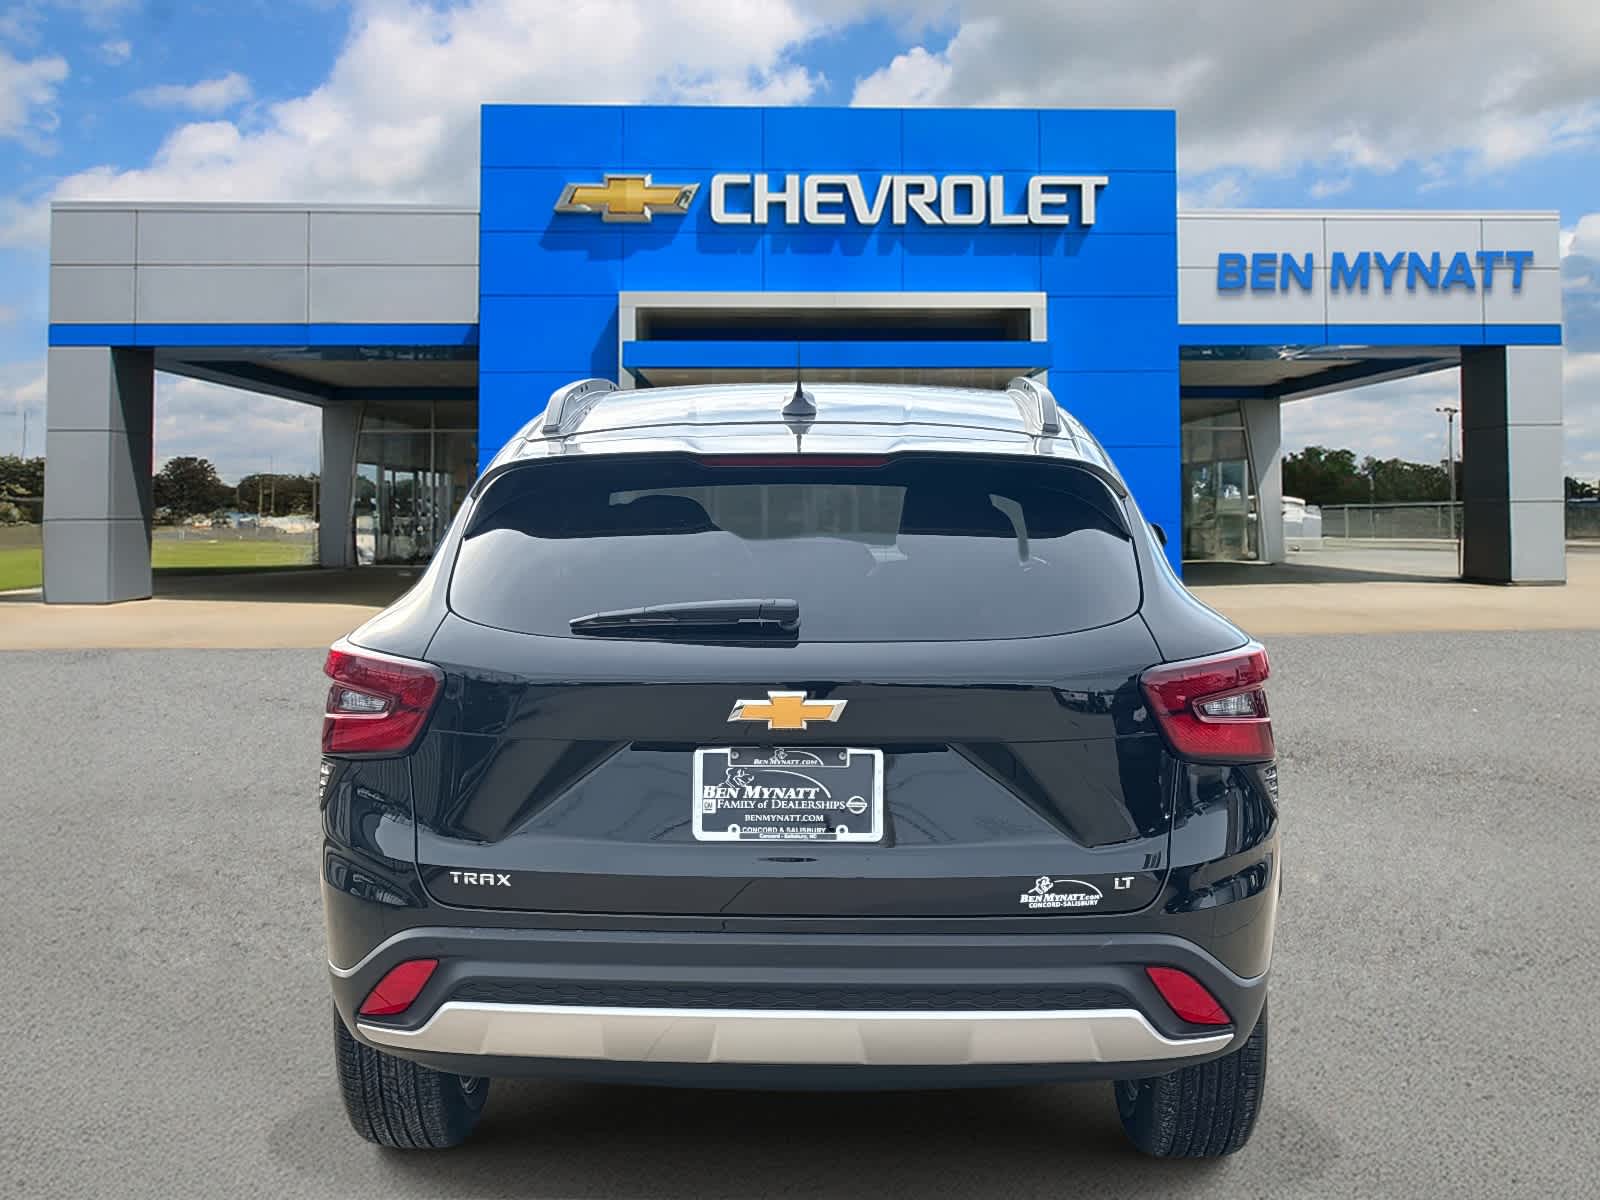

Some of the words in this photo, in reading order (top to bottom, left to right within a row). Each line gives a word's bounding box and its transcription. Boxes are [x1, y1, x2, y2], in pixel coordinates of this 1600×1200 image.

[710, 173, 1109, 226] CHEVROLET
[1217, 252, 1313, 291] BEN
[1330, 251, 1534, 291] MYNATT
[703, 785, 740, 799] BEN
[743, 785, 820, 799] MYNATT
[717, 800, 756, 809] FAMILY
[757, 800, 769, 809] of
[771, 800, 846, 810] DEALERSHIPS
[744, 814, 824, 822] BENMYNATT.COM
[449, 872, 512, 887] TRAX
[1114, 877, 1135, 889] LT
[1020, 893, 1043, 903] BEN
[1028, 900, 1099, 908] CONCORD-SALISBURY
